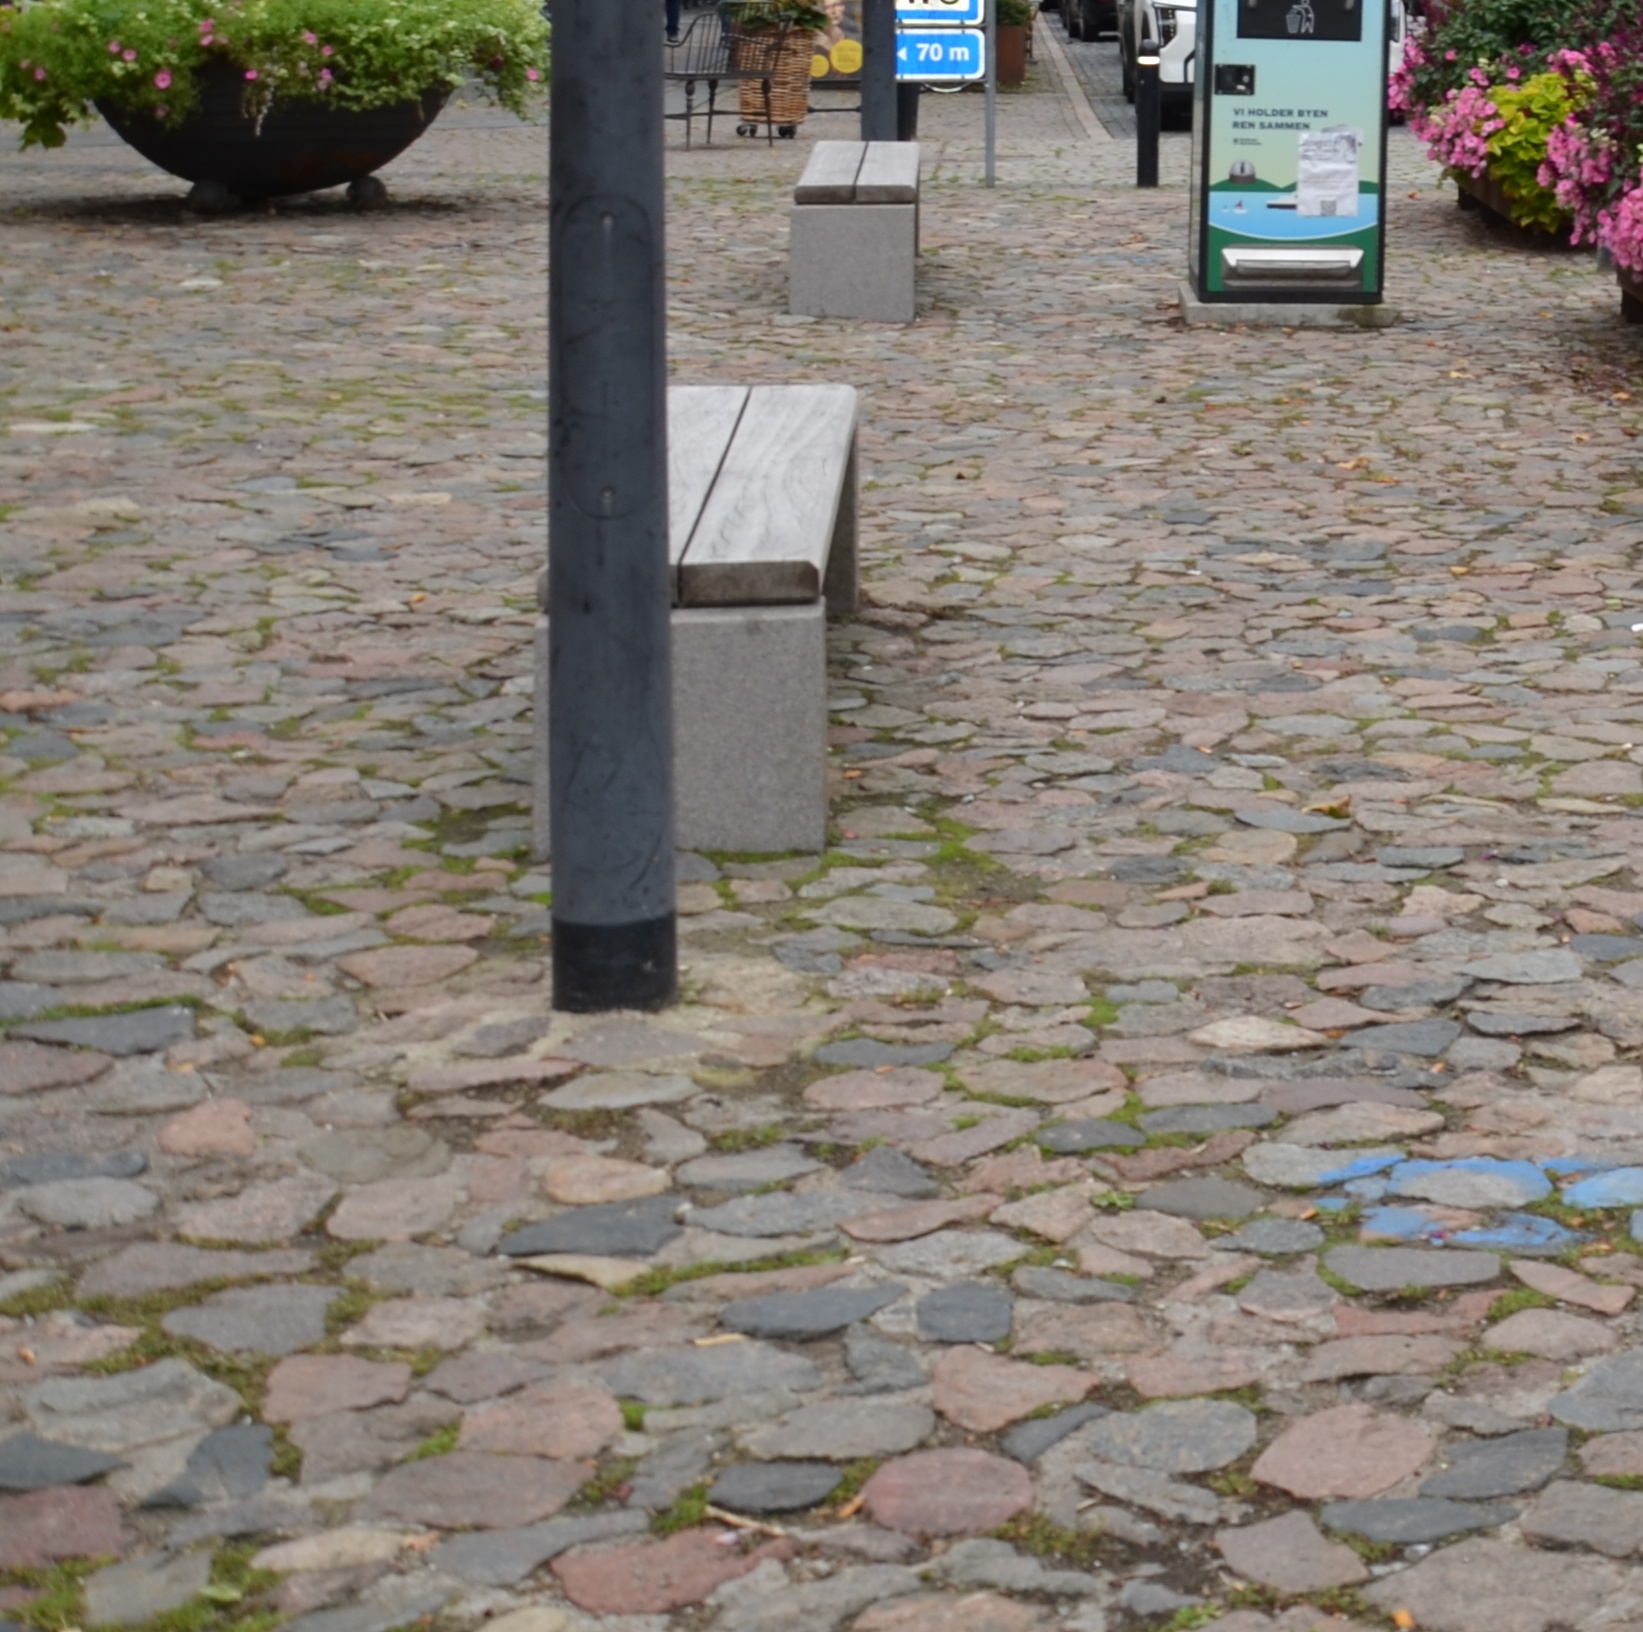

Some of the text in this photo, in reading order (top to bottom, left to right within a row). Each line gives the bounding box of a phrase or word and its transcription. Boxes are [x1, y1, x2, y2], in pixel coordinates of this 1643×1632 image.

[916, 43, 969, 61] 70 m
[1233, 108, 1328, 118] VI HOLDER BYEN
[1233, 121, 1310, 130] REN SAMMEN
